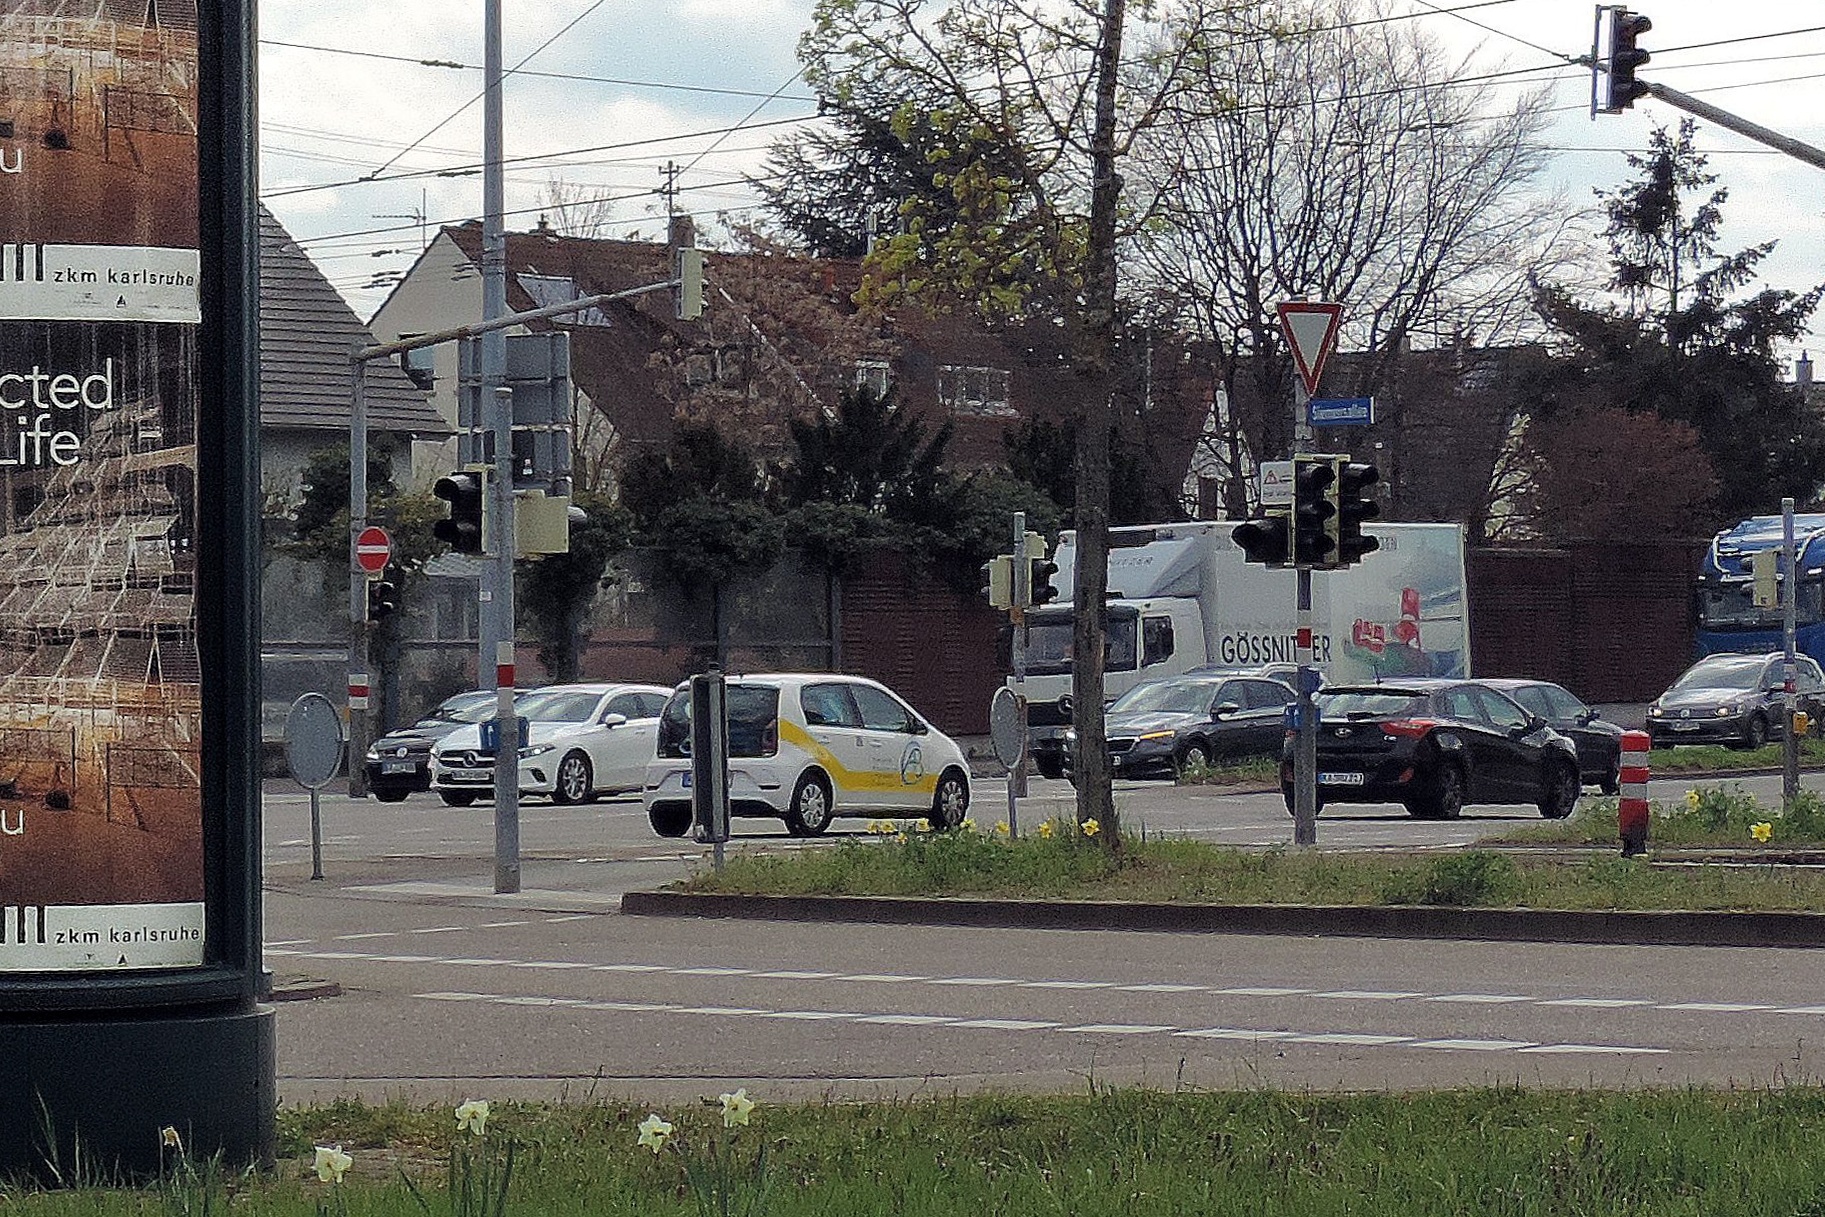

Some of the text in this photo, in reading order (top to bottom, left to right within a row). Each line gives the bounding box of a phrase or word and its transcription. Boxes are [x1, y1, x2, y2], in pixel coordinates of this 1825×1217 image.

[54, 267, 194, 287] zkm karlsruhe
[1221, 631, 1332, 664] GÖSSNITER
[56, 926, 200, 944] zkm karlsruhe
